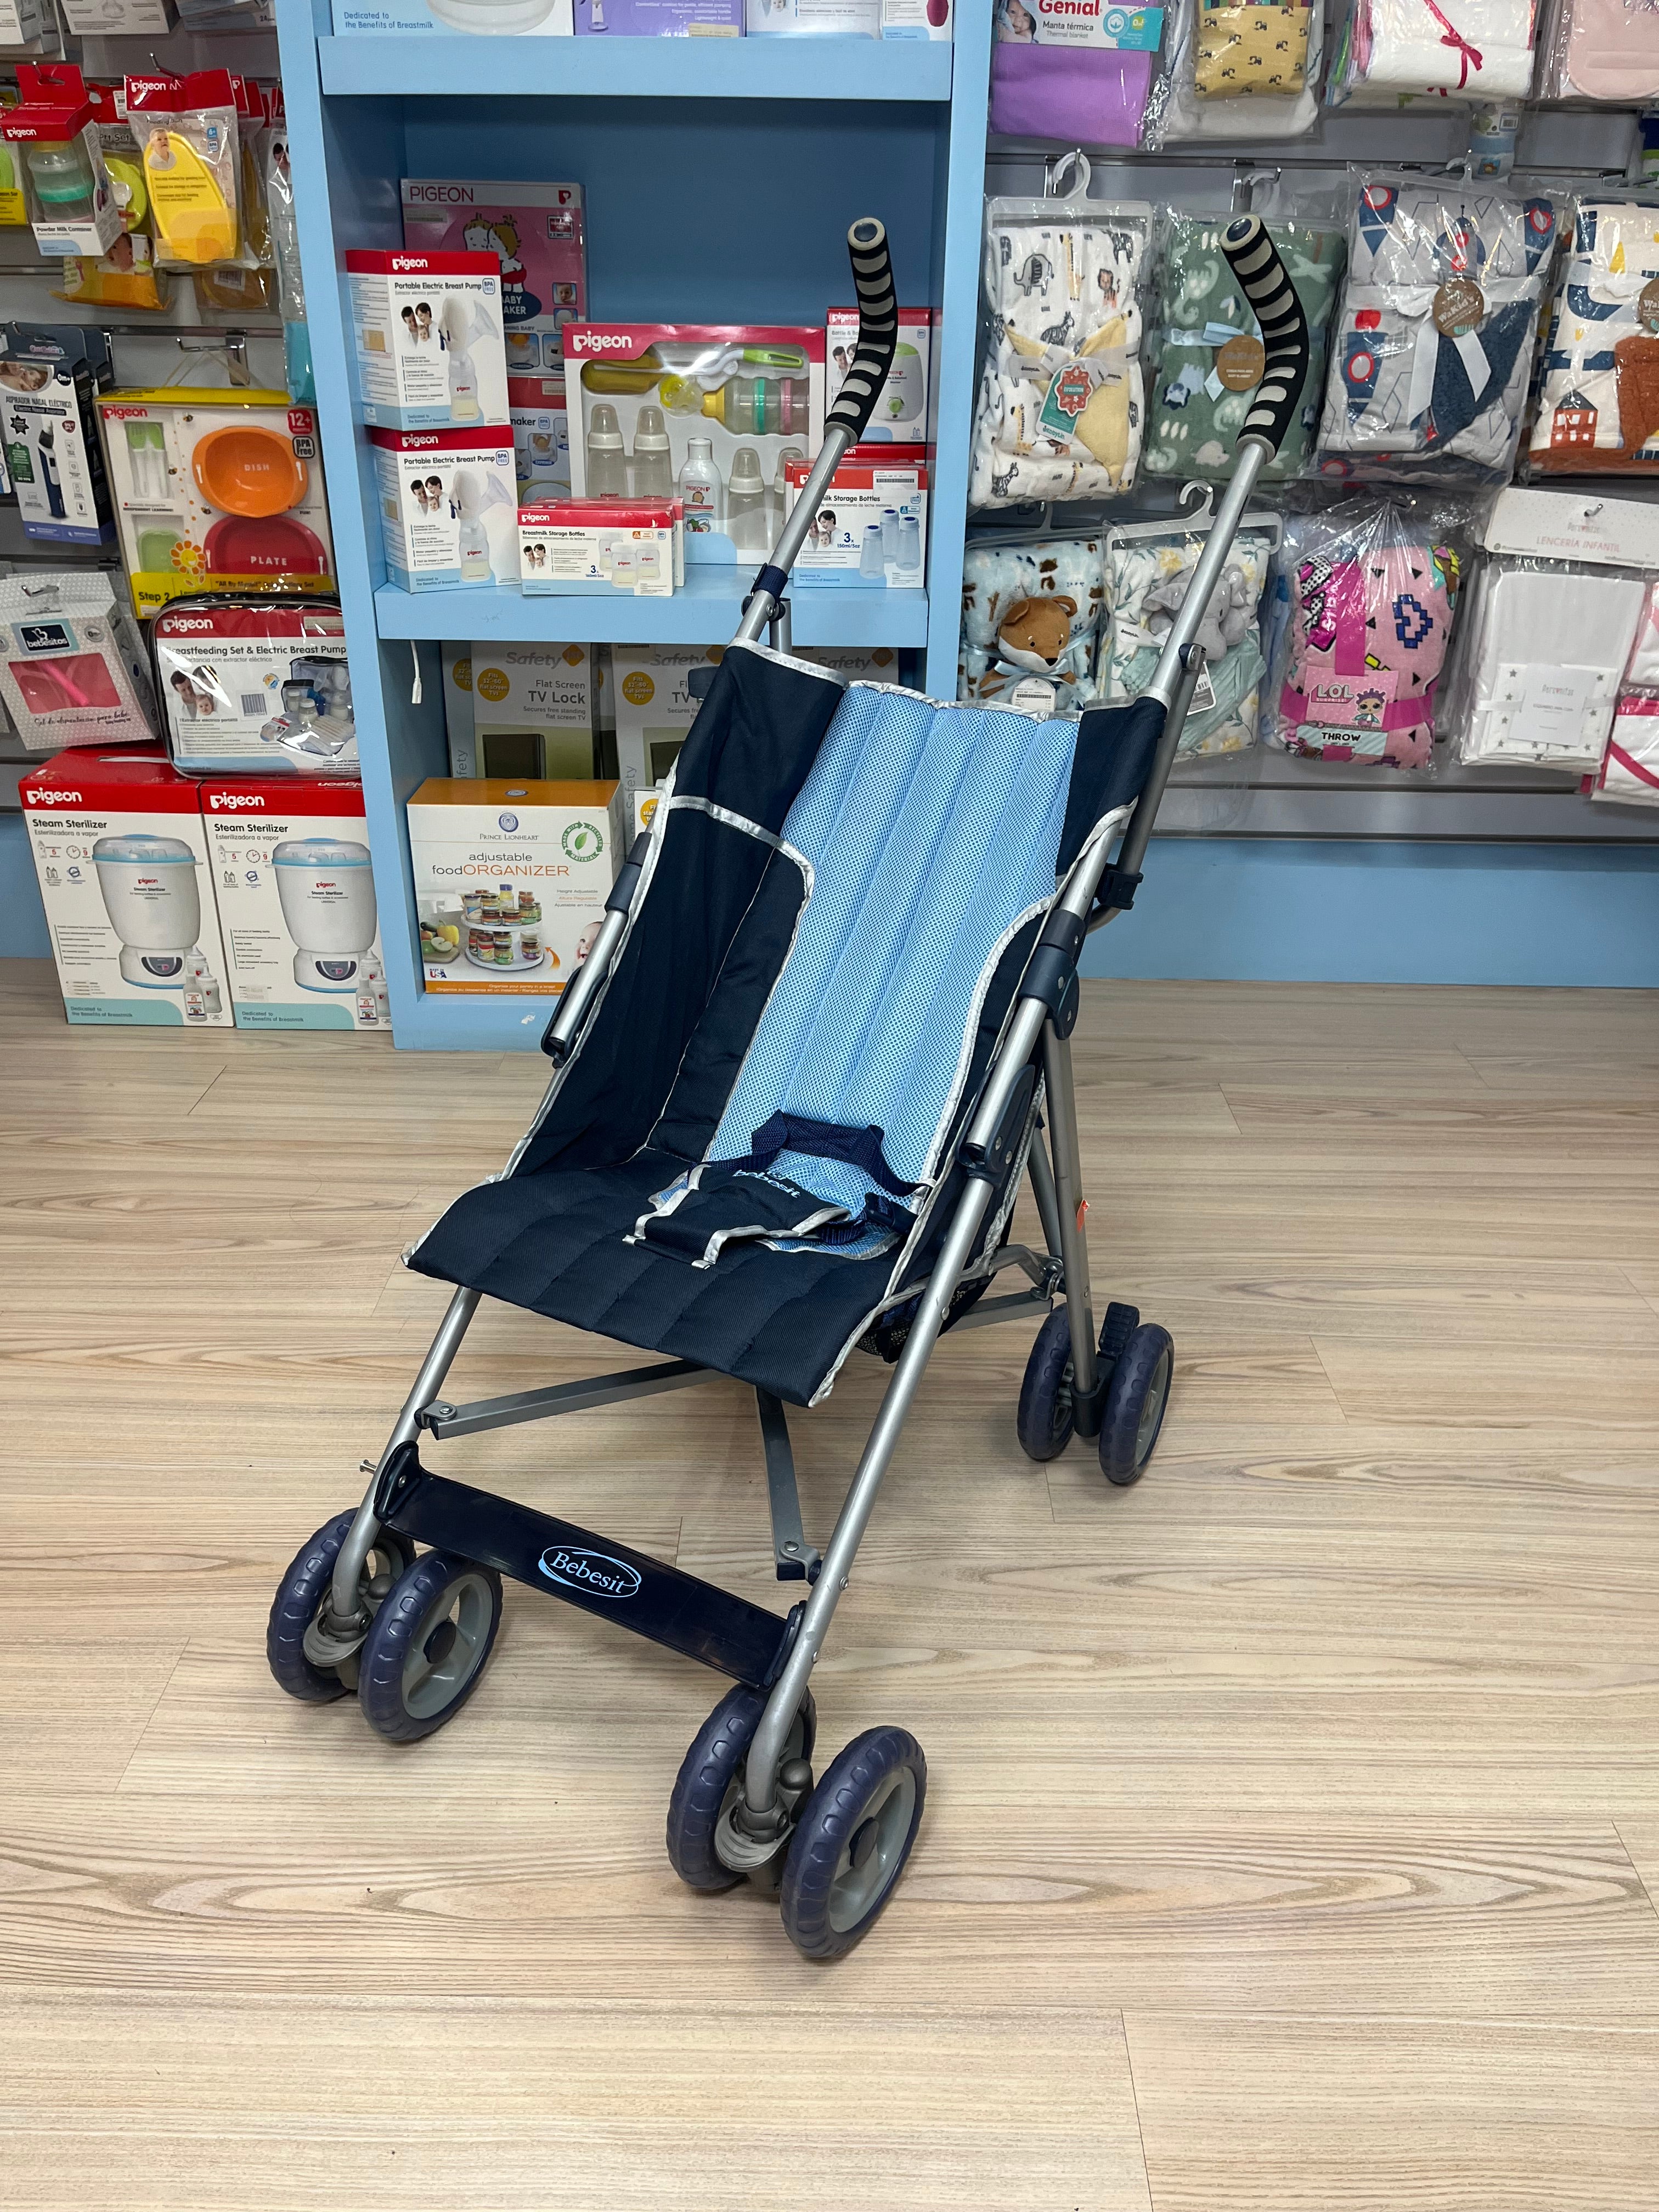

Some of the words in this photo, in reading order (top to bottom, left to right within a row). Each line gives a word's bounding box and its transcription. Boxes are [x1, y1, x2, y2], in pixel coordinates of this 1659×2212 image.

[1039, 0, 1100, 16] Genial
[1042, 21, 1065, 30] Manta
[1066, 22, 1094, 31] térmica
[131, 80, 166, 93] pigeon
[6, 128, 37, 138] pigeon
[410, 186, 473, 202] PIGEON
[392, 255, 428, 270] pigeon
[832, 312, 859, 323] pigeon
[573, 330, 633, 352] pigeon
[103, 405, 148, 420] pigeon
[289, 413, 311, 426] 12+
[295, 439, 311, 448] BPA
[402, 433, 438, 448] pigeon
[244, 463, 269, 472] DISH
[521, 512, 550, 523] pigeon
[844, 532, 851, 543] 3
[1537, 536, 1579, 548] LENCERÍA
[1582, 542, 1620, 553] INFANTIL
[250, 556, 287, 566] PLATE
[590, 565, 596, 573] 3
[139, 592, 161, 603] Step
[165, 592, 170, 601] 2
[162, 616, 213, 632] pigeon
[166, 646, 228, 656] eastfeeding
[230, 646, 244, 654] Set
[321, 646, 346, 655] Pump
[506, 651, 562, 669] Safety
[1317, 684, 1355, 698] LOL
[528, 691, 546, 702] TV
[552, 691, 585, 704] Lock
[672, 692, 689, 703] TV
[1322, 732, 1361, 741] THROW
[26, 787, 82, 805] pigeon
[210, 792, 265, 809] pigeon
[32, 819, 63, 828] Steam
[65, 820, 107, 829] Sterilizer
[215, 823, 245, 832] Steam
[247, 823, 288, 833] Sterilizer
[567, 824, 578, 832] WITH
[589, 826, 602, 847] RECYCLED
[469, 853, 532, 863] adjustable
[432, 864, 570, 876] foodORGANIZER
[430, 970, 447, 979] USA
[732, 1170, 800, 1198] bebesit
[550, 1551, 624, 1593] Bebesit
